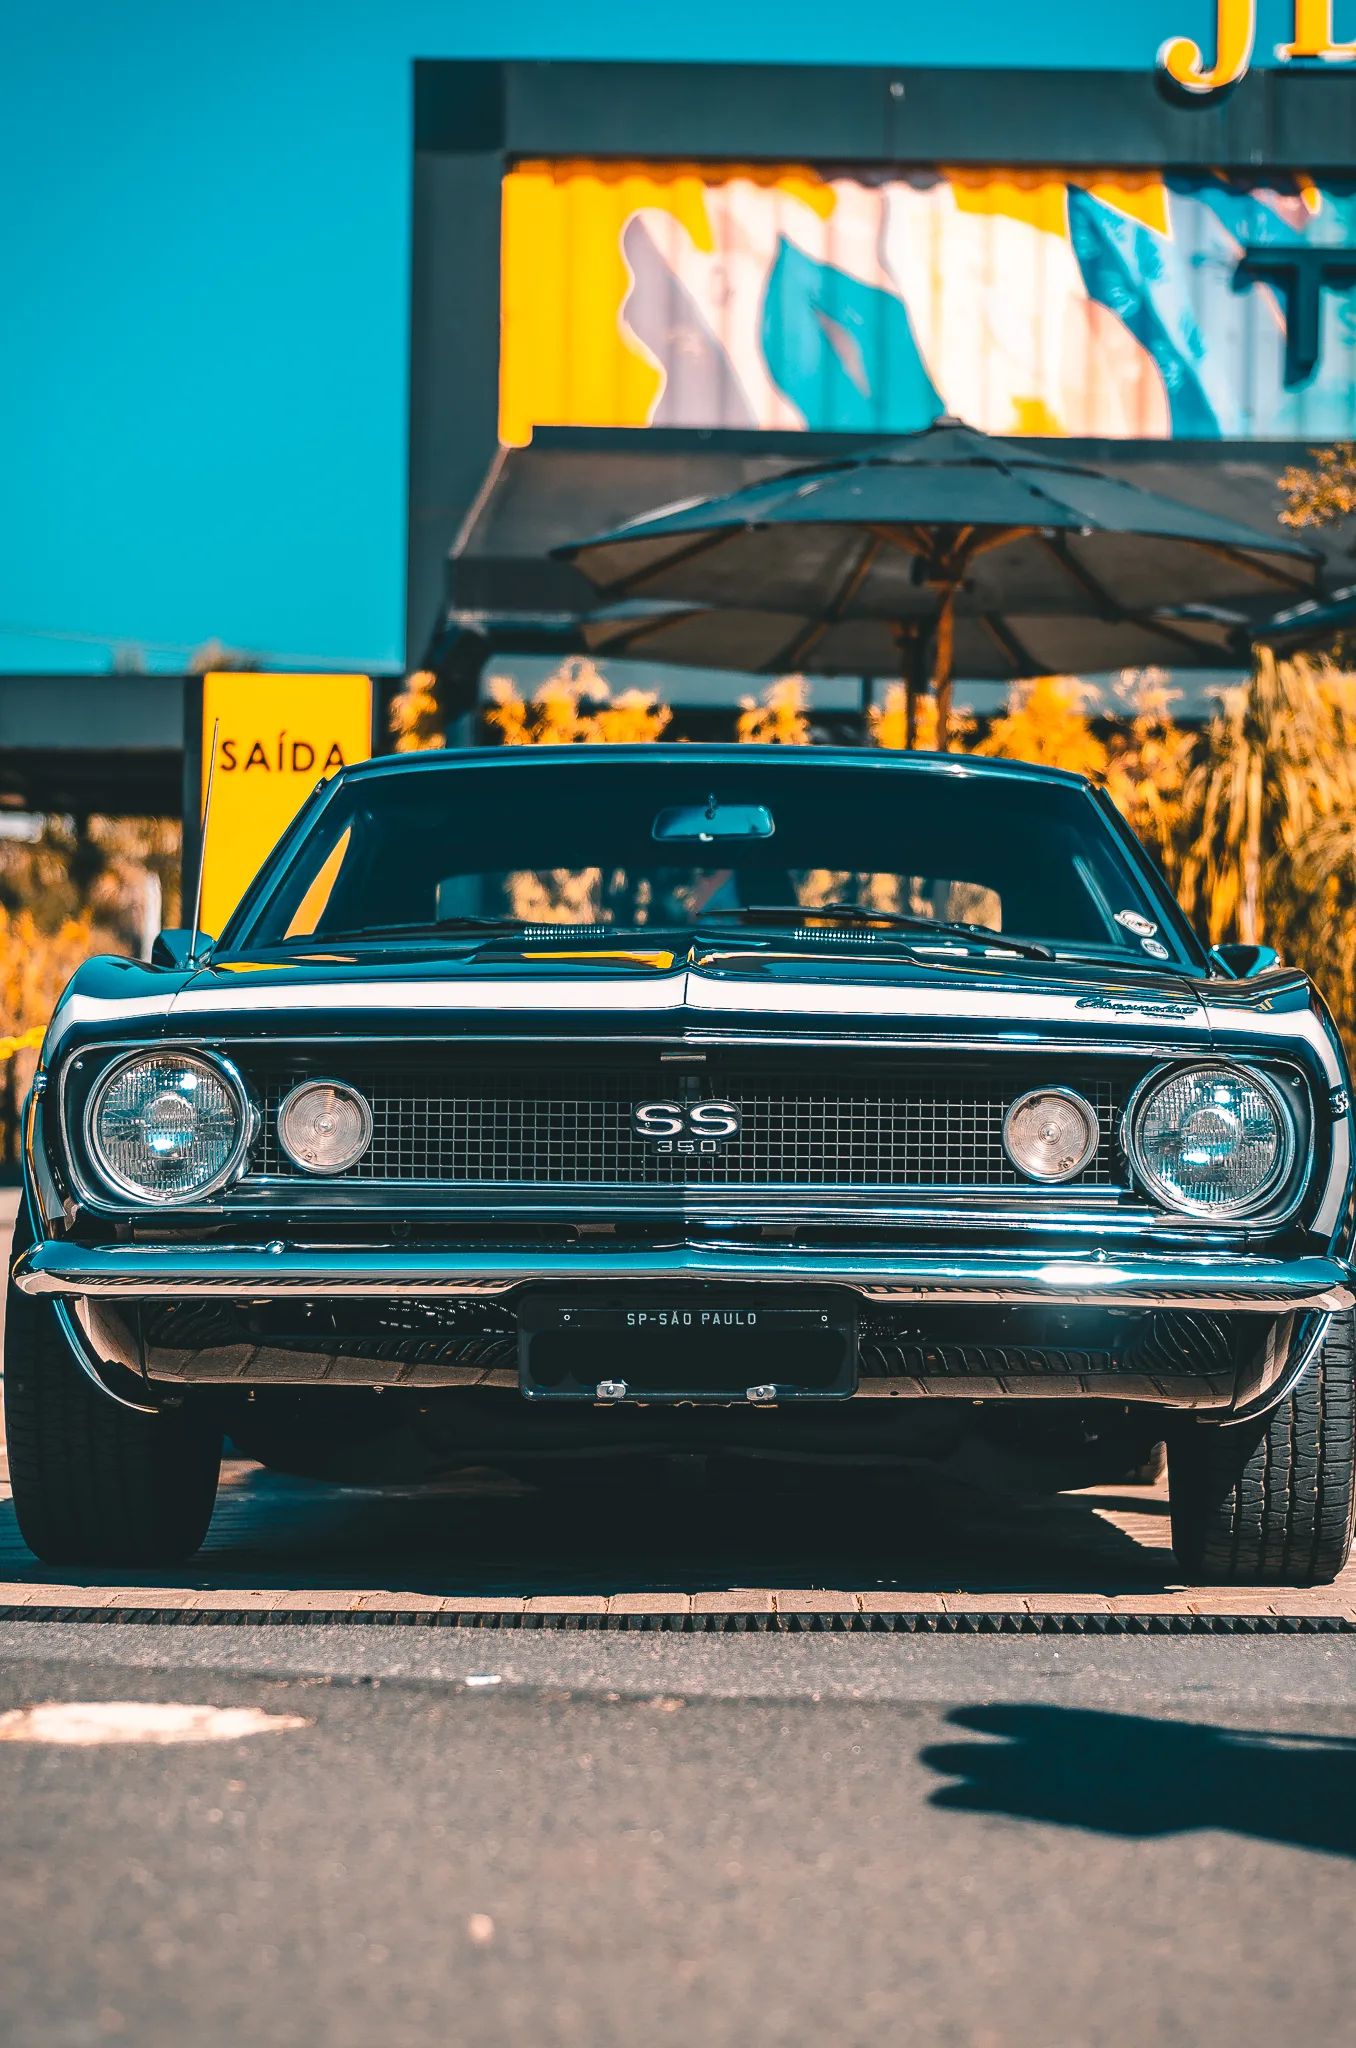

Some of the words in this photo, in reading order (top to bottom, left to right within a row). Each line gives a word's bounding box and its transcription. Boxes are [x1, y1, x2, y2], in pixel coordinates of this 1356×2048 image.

[220, 730, 346, 772] SAÍDA
[634, 1102, 739, 1137] SS
[657, 1140, 717, 1153] 350
[627, 1310, 692, 1326] SP-SÃO
[701, 1312, 757, 1325] PAULO
